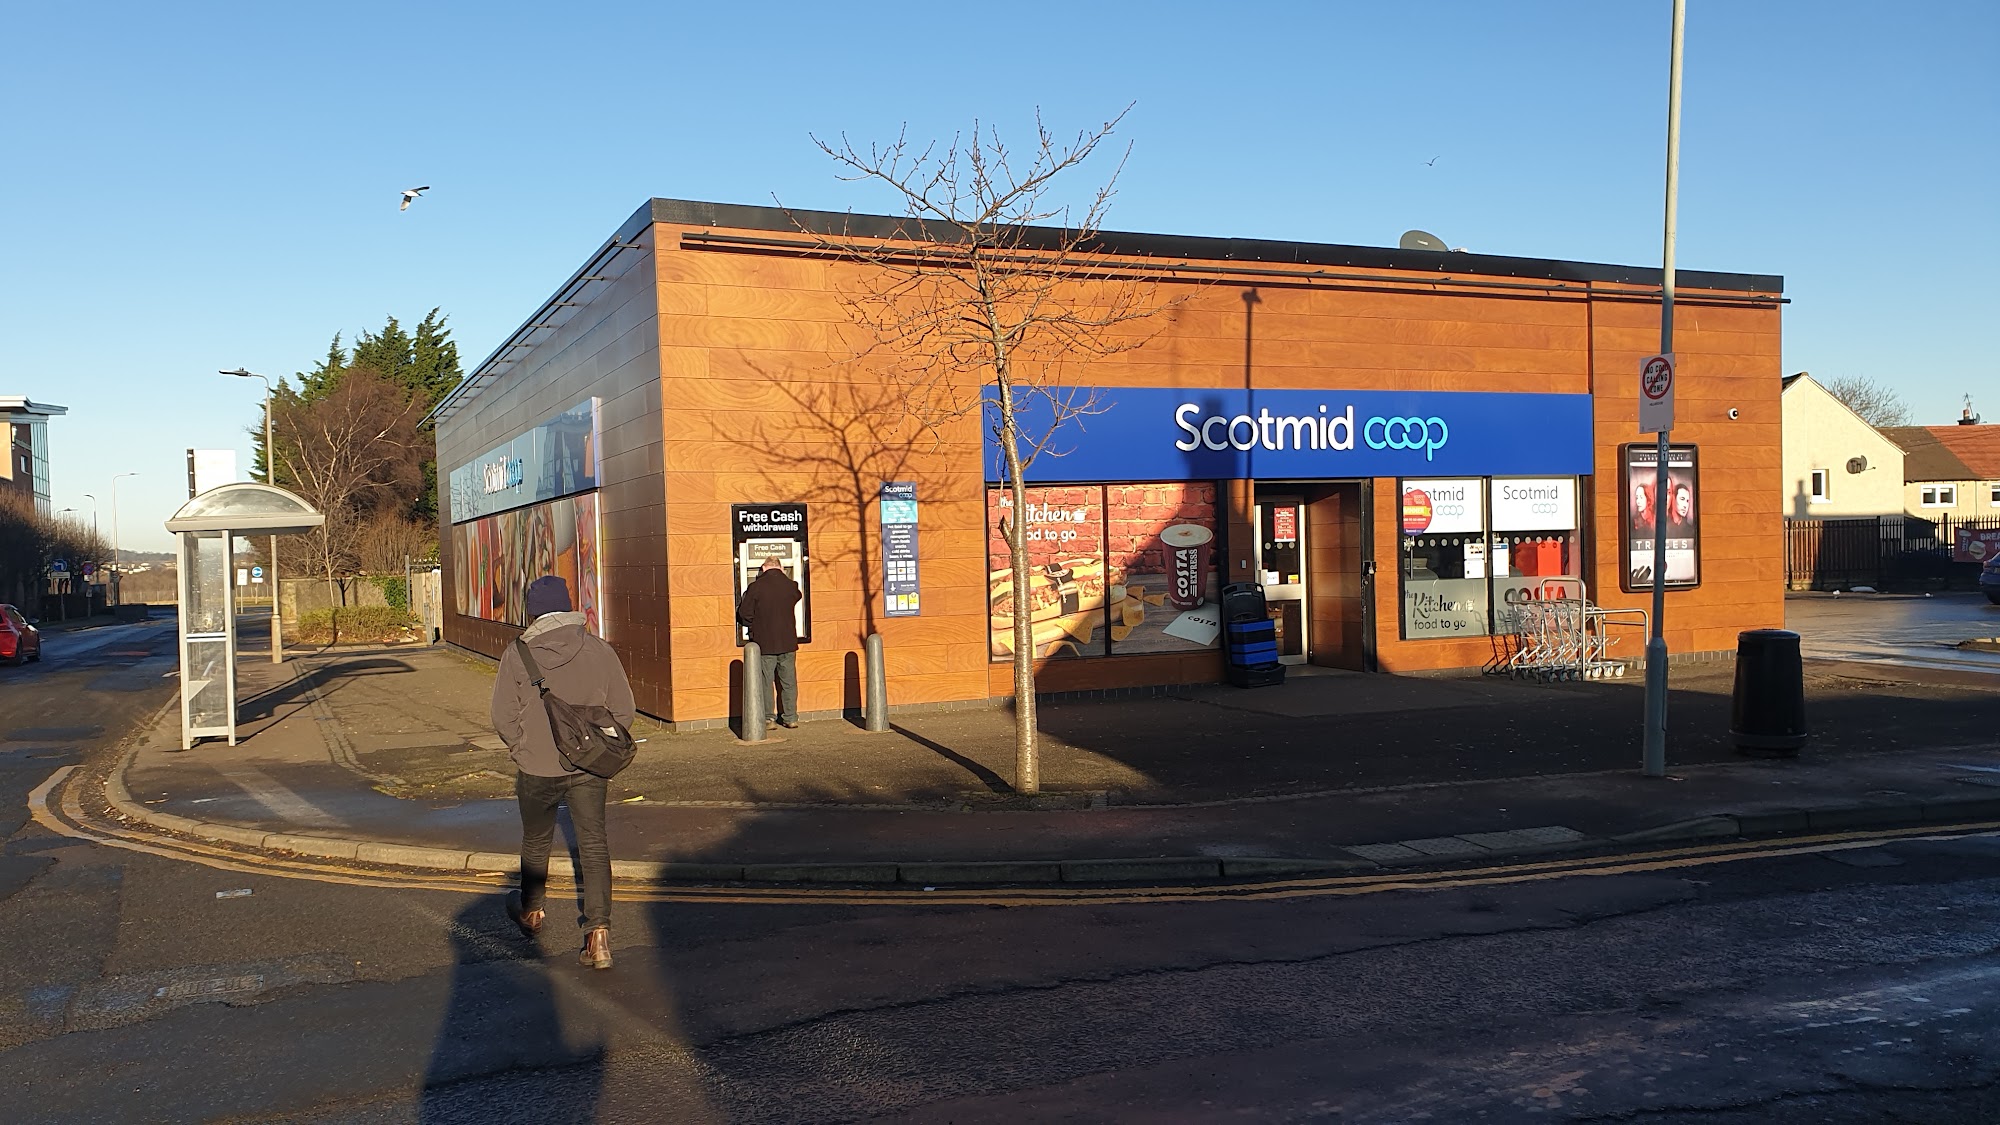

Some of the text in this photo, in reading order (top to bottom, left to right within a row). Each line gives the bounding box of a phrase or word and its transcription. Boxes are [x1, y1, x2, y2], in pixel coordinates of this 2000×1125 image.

[1175, 403, 1449, 462] Scotmid coop
[884, 485, 913, 493] Scotmid
[1405, 486, 1465, 501] otmid
[1503, 485, 1559, 500] Scotmid
[738, 510, 803, 522] Free Cash
[1436, 505, 1465, 519] coop
[1531, 503, 1559, 519] coop
[742, 522, 799, 532] withdrawals
[1044, 529, 1058, 540] to
[1060, 530, 1077, 542] go
[1635, 540, 1688, 550] TRCES
[1189, 548, 1198, 584] EXPRESS
[1175, 549, 1190, 598] COSTA
[1412, 592, 1462, 619] Kitchen
[1187, 615, 1217, 627] COSTA
[1414, 618, 1467, 630] food to go
